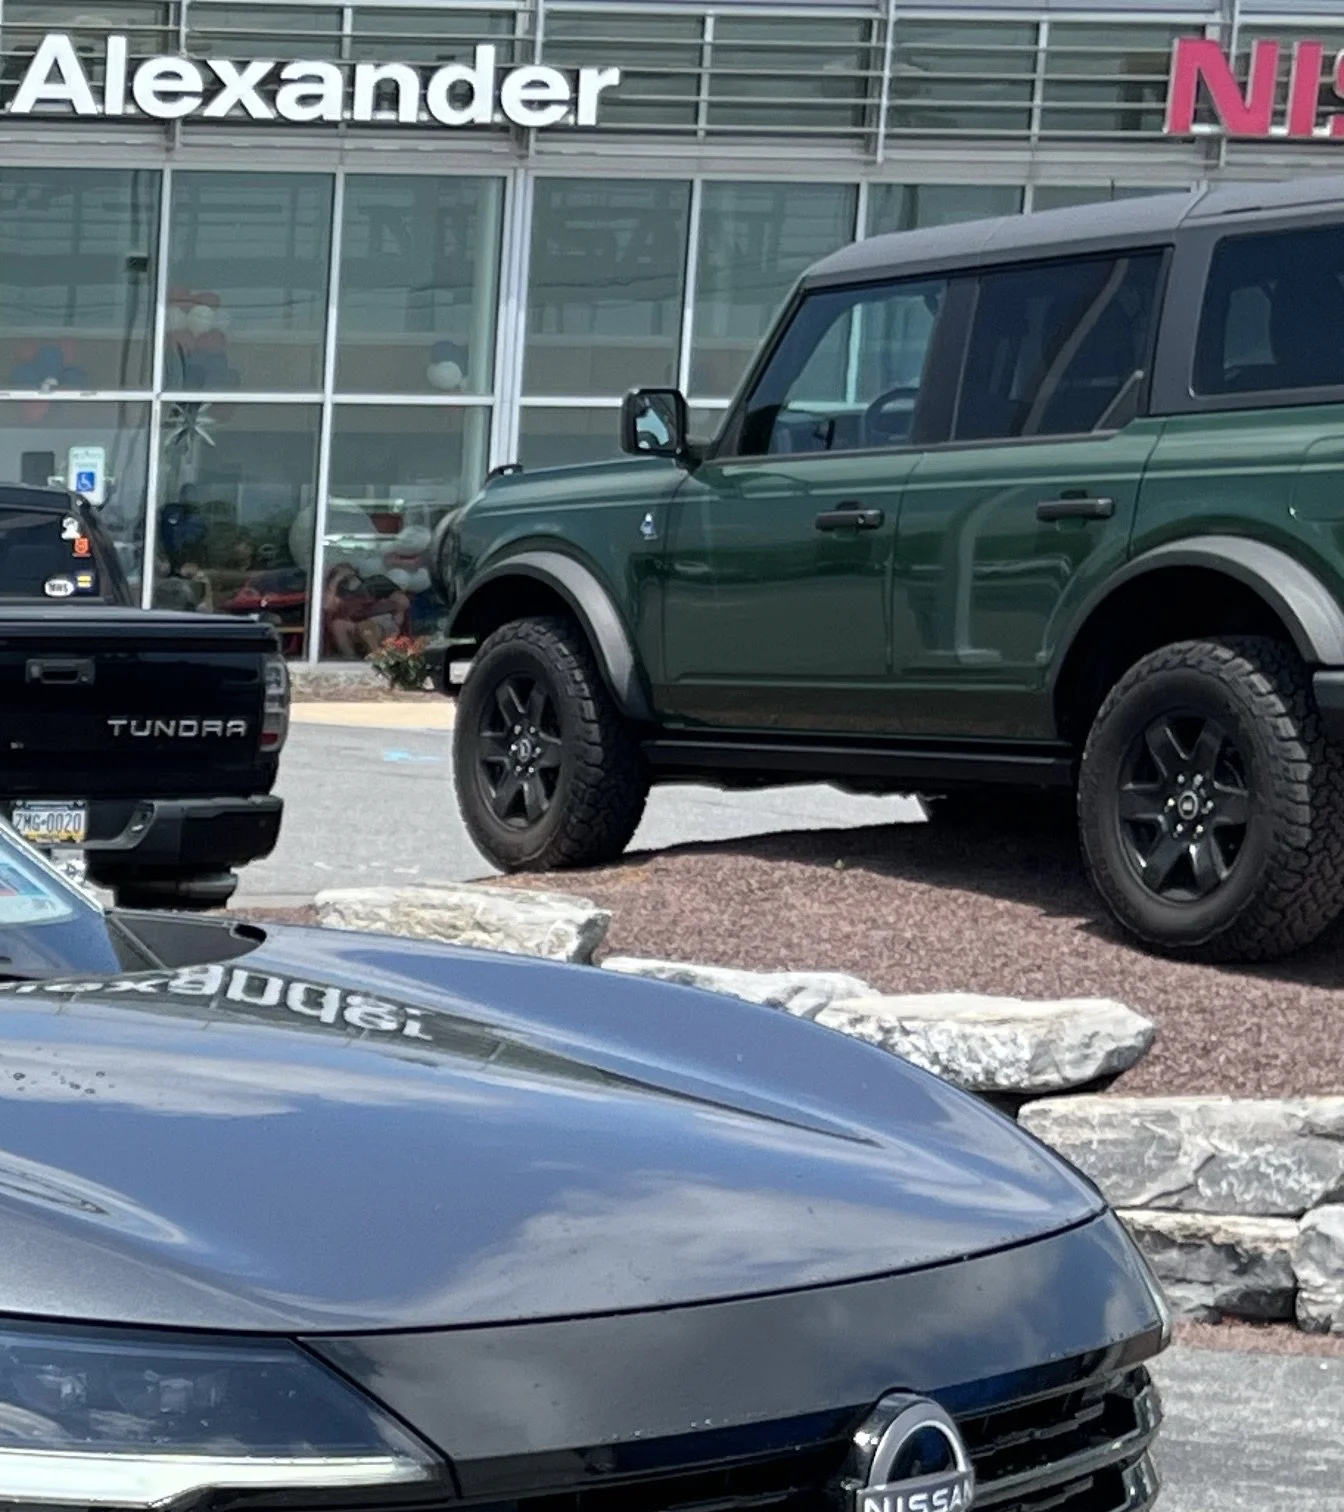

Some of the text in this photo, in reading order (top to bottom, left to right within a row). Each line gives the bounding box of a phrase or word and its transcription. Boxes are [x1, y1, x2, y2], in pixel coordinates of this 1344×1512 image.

[9, 34, 620, 127] Alexander
[1163, 36, 1344, 138] NI
[107, 720, 248, 738] TUNDRA
